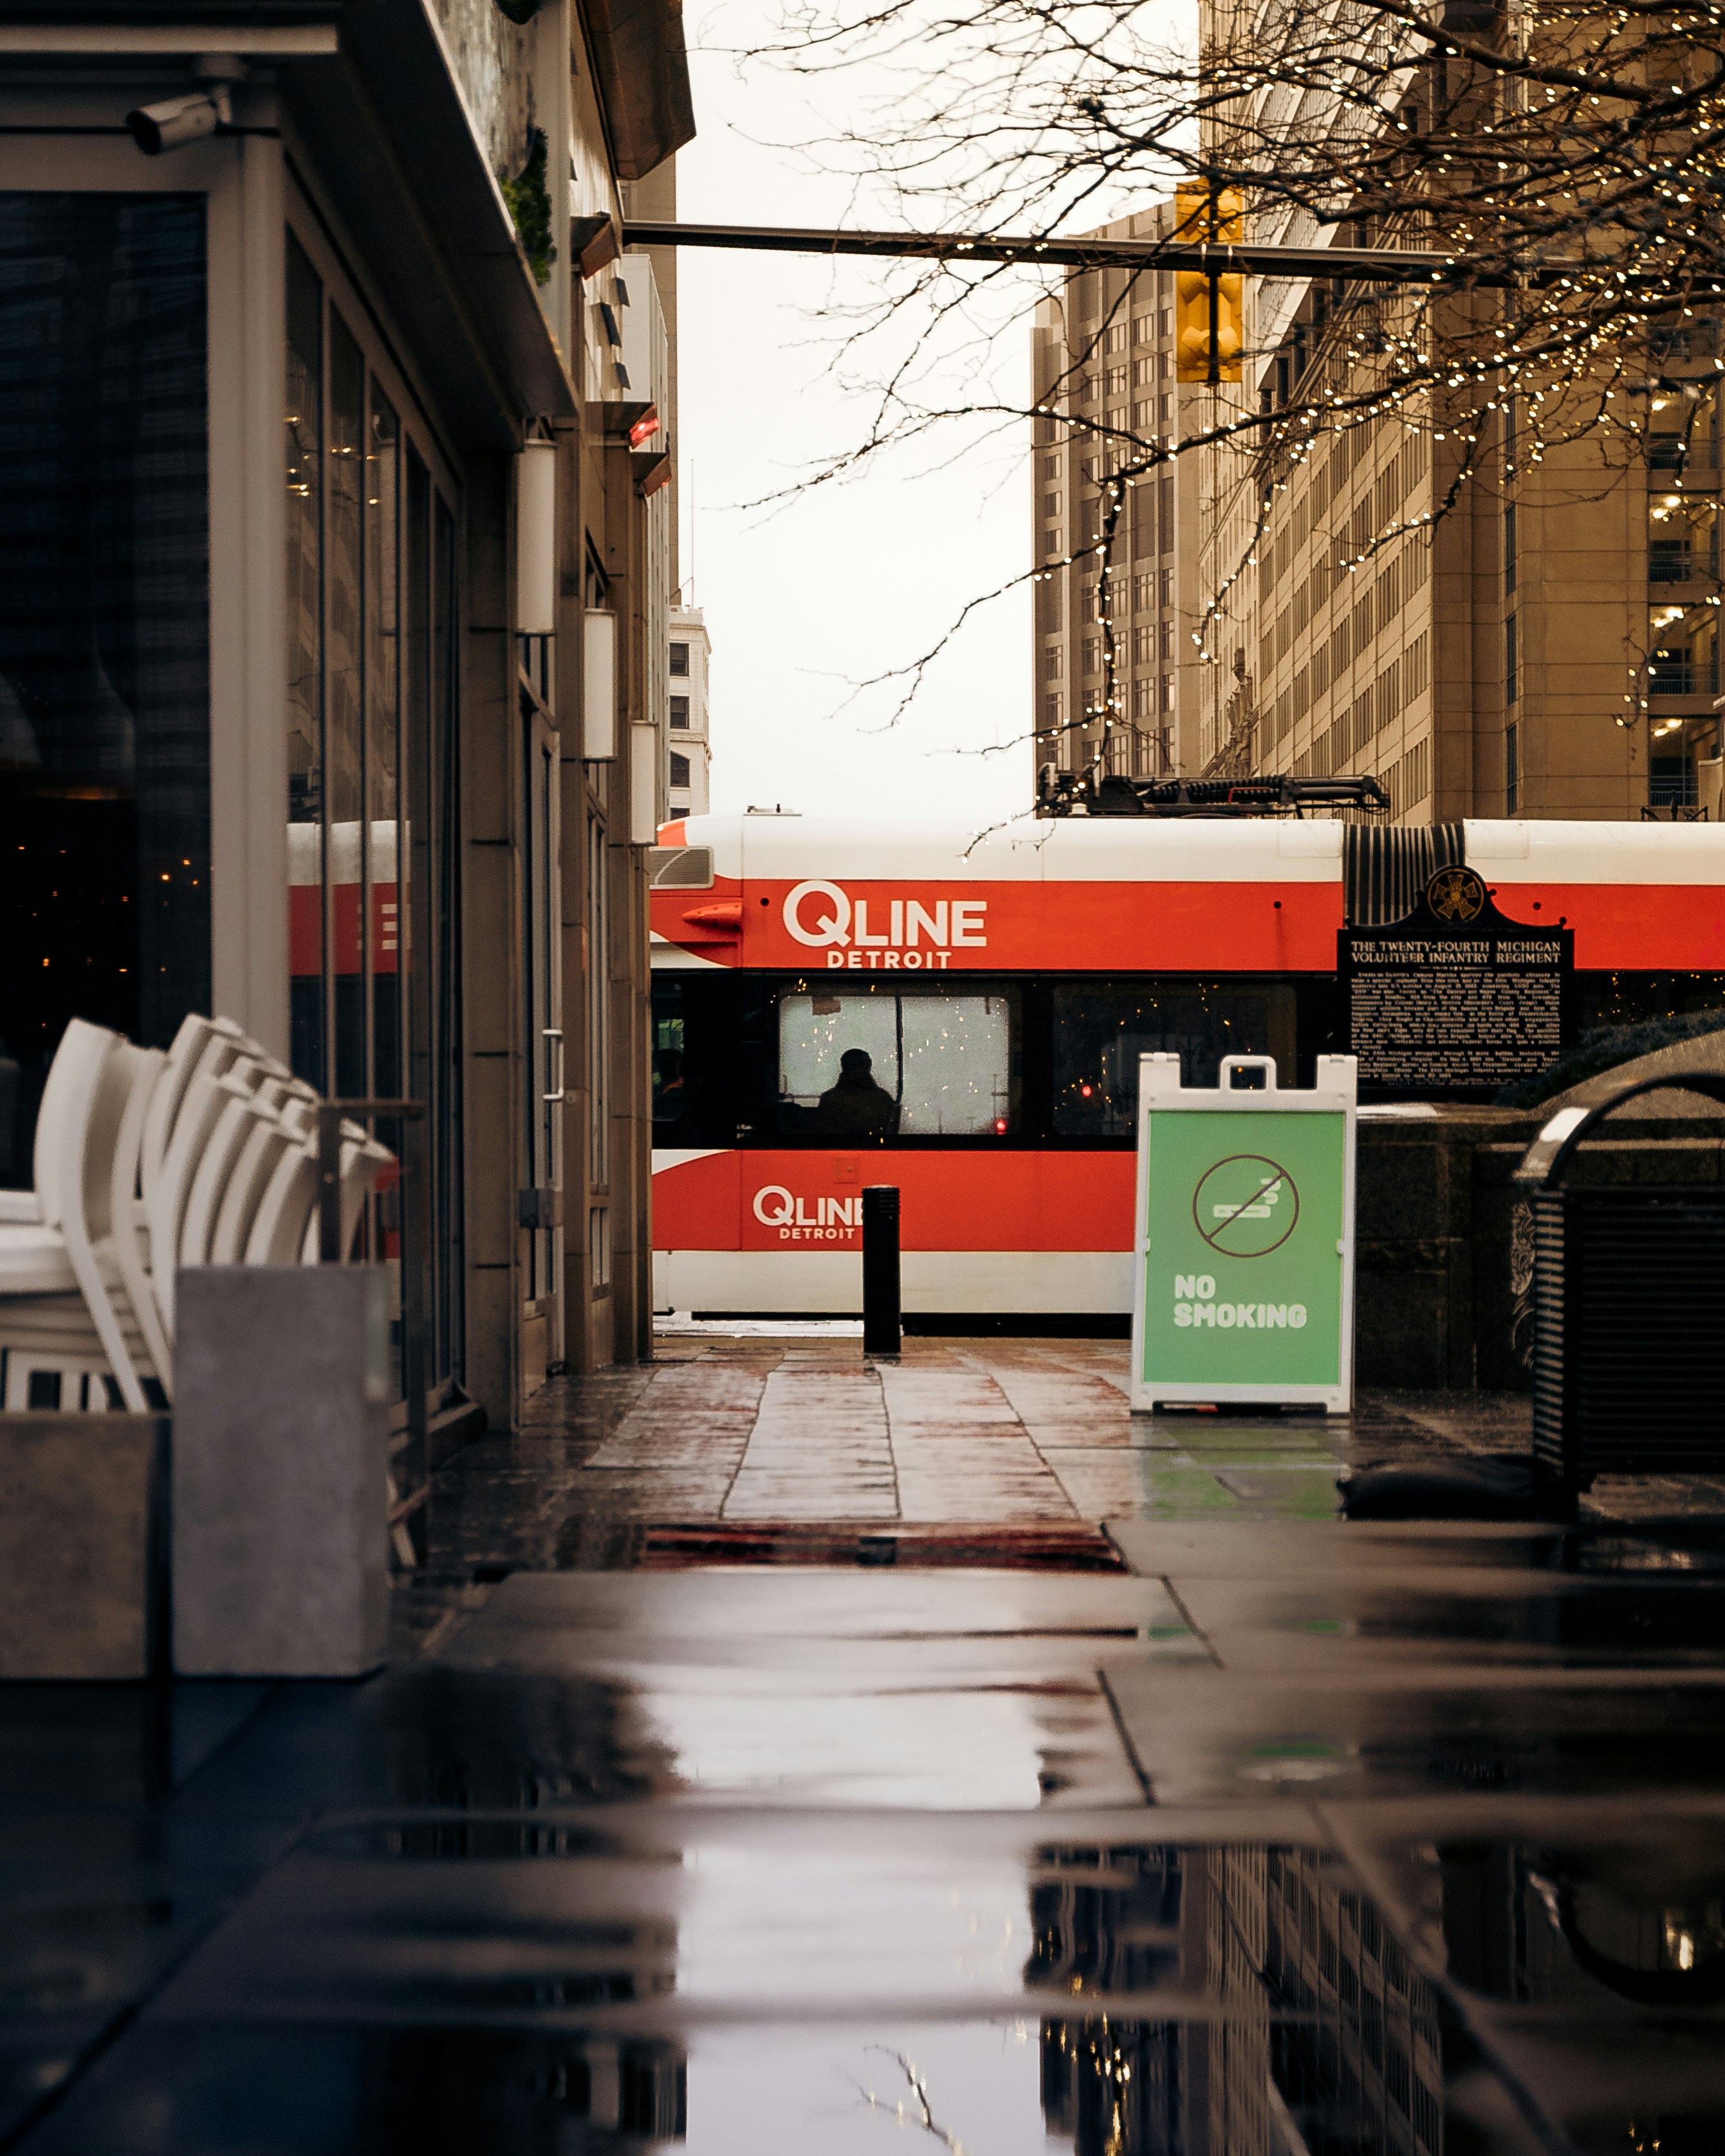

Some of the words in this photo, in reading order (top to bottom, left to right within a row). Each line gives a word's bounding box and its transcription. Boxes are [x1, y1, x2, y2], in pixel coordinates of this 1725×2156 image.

[782, 880, 988, 948] QLINE
[1351, 941, 1376, 952] THE
[1379, 941, 1490, 952] TWENTY-FOURTH
[1497, 941, 1561, 952] MICHIGAN
[827, 951, 952, 969] DETROIT
[1352, 952, 1425, 963] VOLUNTEER
[1430, 952, 1490, 963] INFANTRY
[1496, 952, 1561, 963] REGIMENT
[779, 1228, 855, 1239] DETROIT
[1174, 1275, 1215, 1299] NO
[1174, 1304, 1307, 1329] SMOKING
